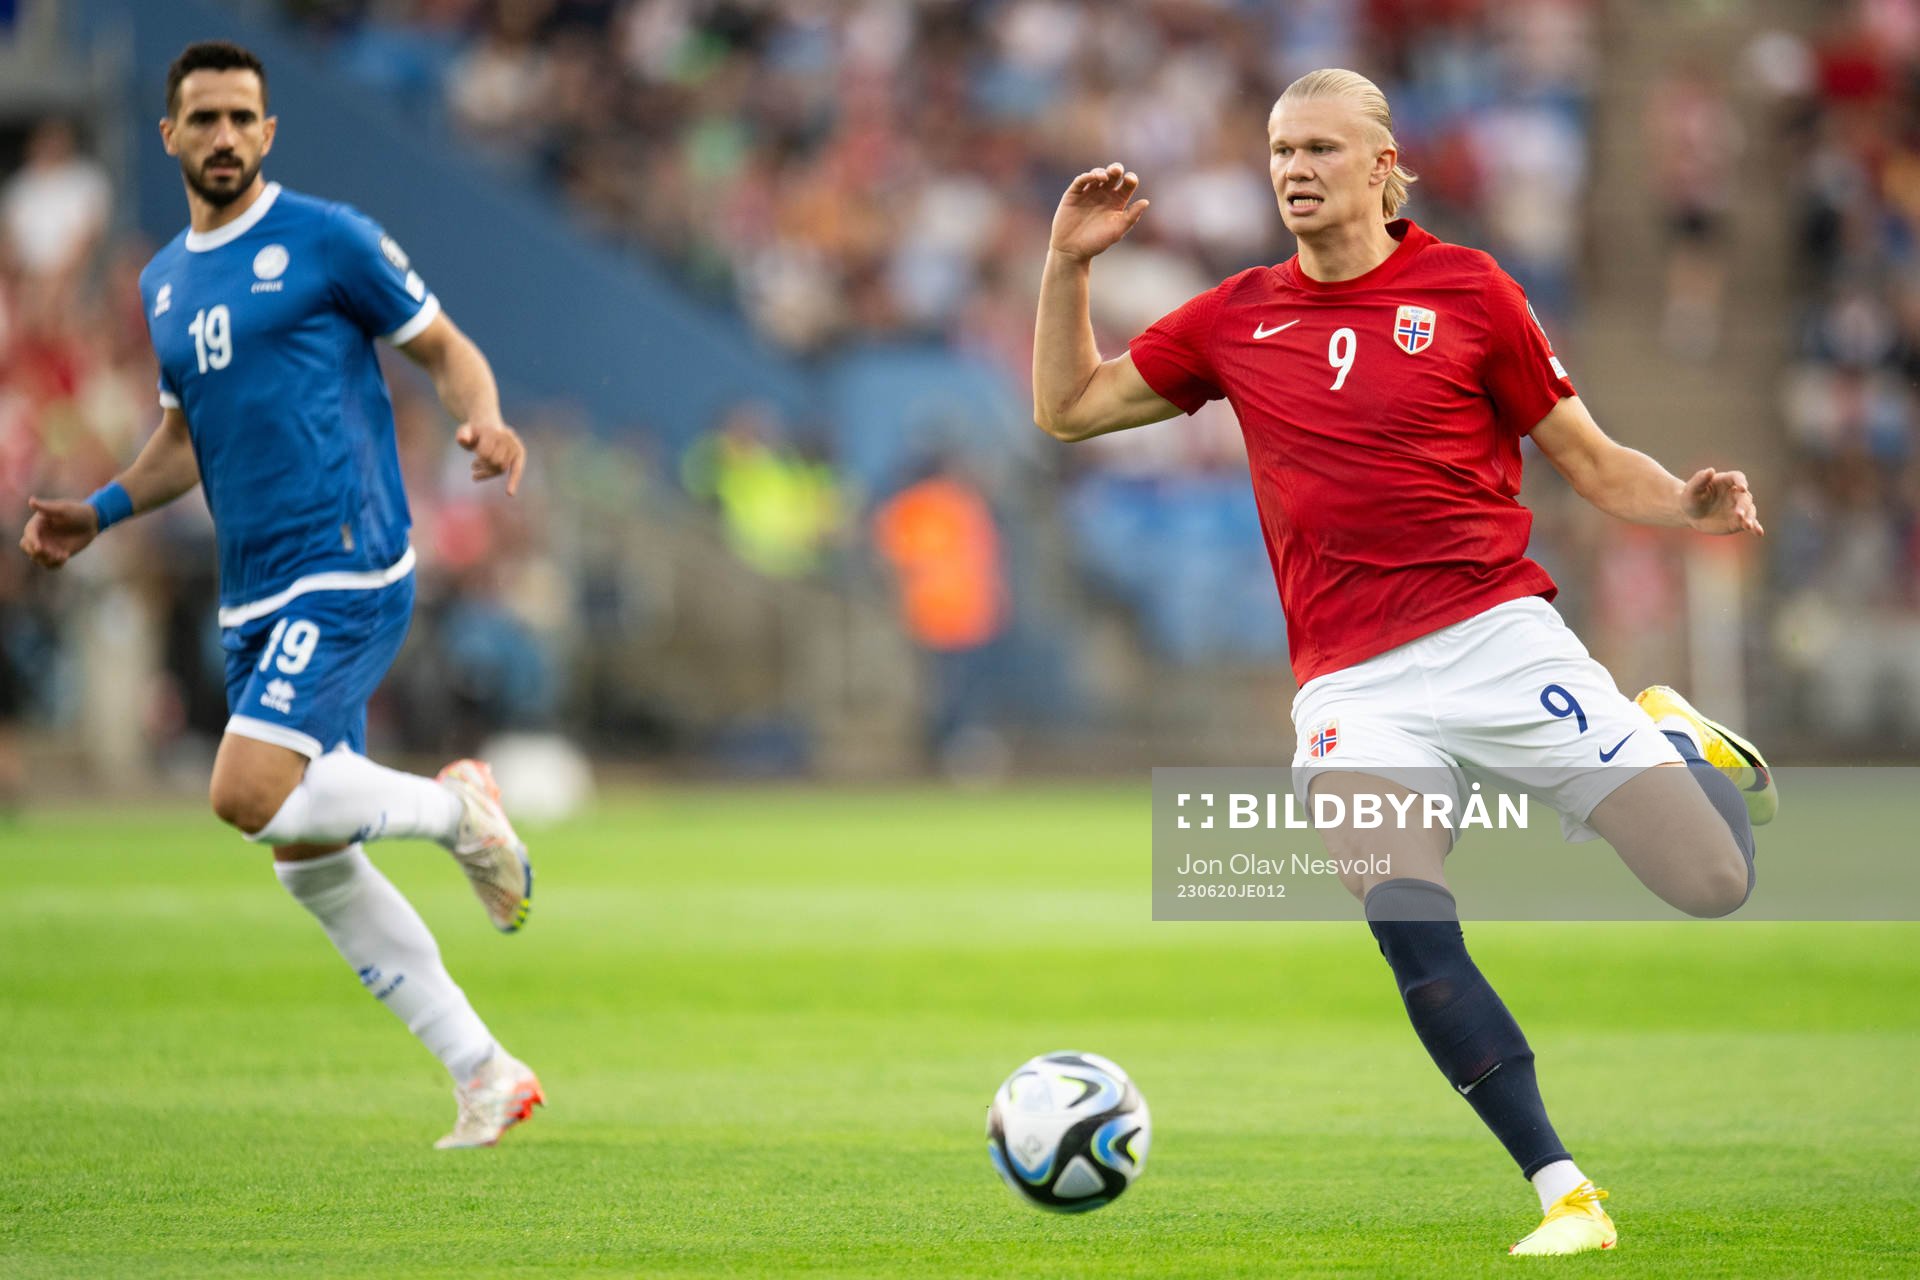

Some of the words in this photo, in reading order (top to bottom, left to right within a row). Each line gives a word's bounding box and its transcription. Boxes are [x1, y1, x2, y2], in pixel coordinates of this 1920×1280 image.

[188, 304, 233, 374] 19
[1328, 327, 1357, 390] 9
[258, 617, 320, 675] 19
[1540, 684, 1588, 734] 9
